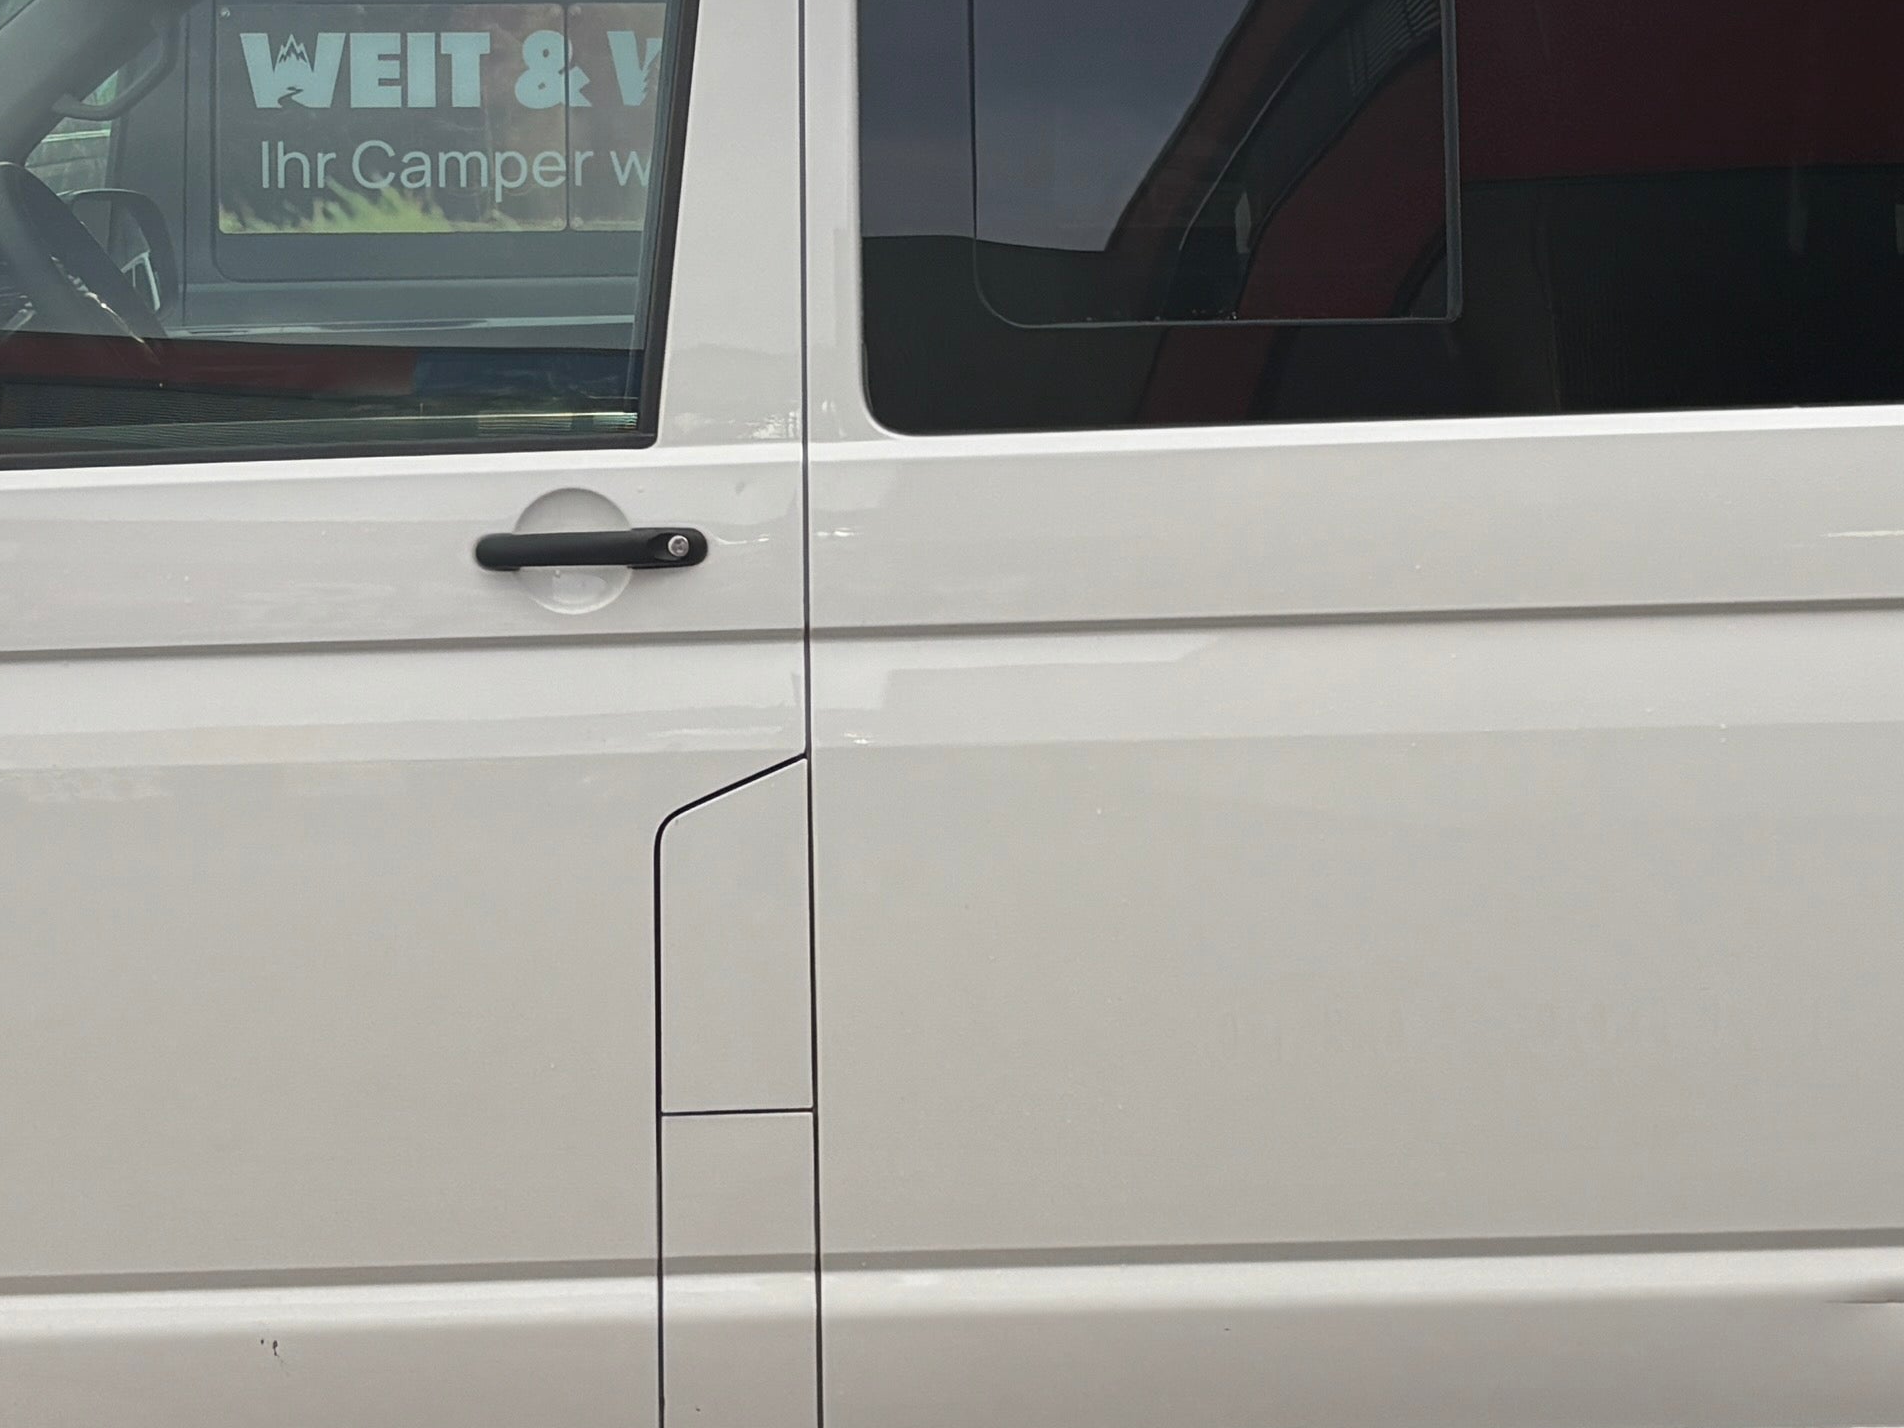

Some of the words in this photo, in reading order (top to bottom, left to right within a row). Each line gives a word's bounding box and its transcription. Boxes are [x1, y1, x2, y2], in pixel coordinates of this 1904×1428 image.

[239, 31, 492, 109] WEIT
[514, 29, 593, 110] &
[260, 140, 337, 189] Ihr
[351, 139, 594, 203] Camper
